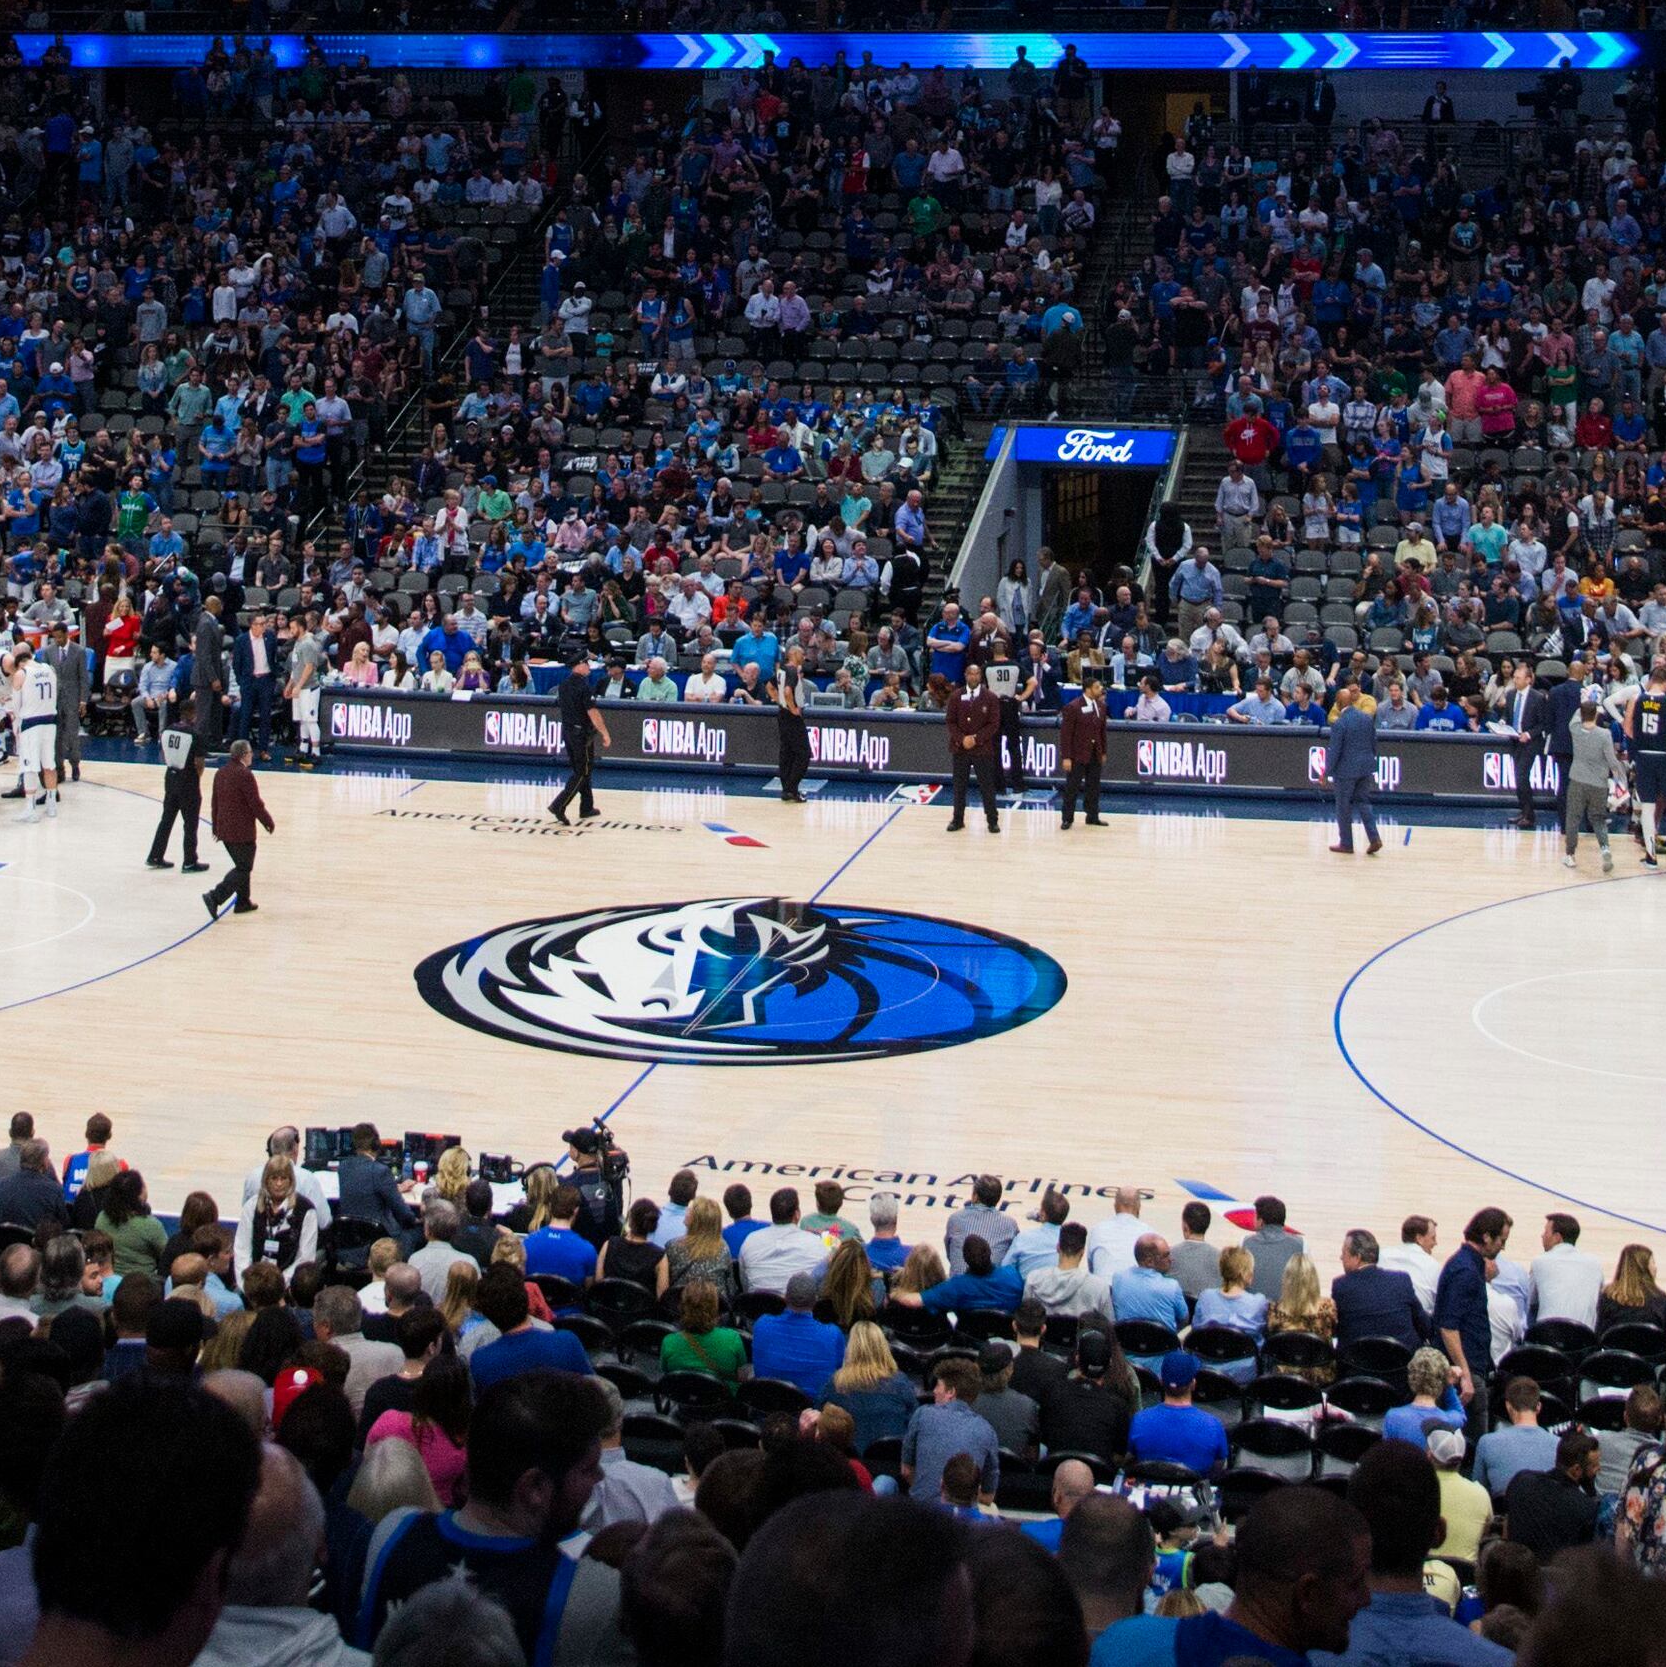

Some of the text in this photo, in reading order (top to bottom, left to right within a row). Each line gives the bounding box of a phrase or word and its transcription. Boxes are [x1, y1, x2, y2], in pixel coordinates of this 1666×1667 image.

[1057, 428, 1135, 463] Ford
[35, 682, 52, 700] 77
[997, 668, 1010, 682] 30
[347, 705, 412, 746] NBA App
[501, 711, 538, 747] NBA
[657, 719, 726, 762] NBA App
[1642, 712, 1660, 734] 15
[821, 726, 890, 771] NBA App
[1024, 740, 1056, 778] App
[1154, 741, 1227, 784] NBA App
[373, 808, 541, 826] American
[470, 822, 594, 837] Center
[681, 1154, 939, 1188] American
